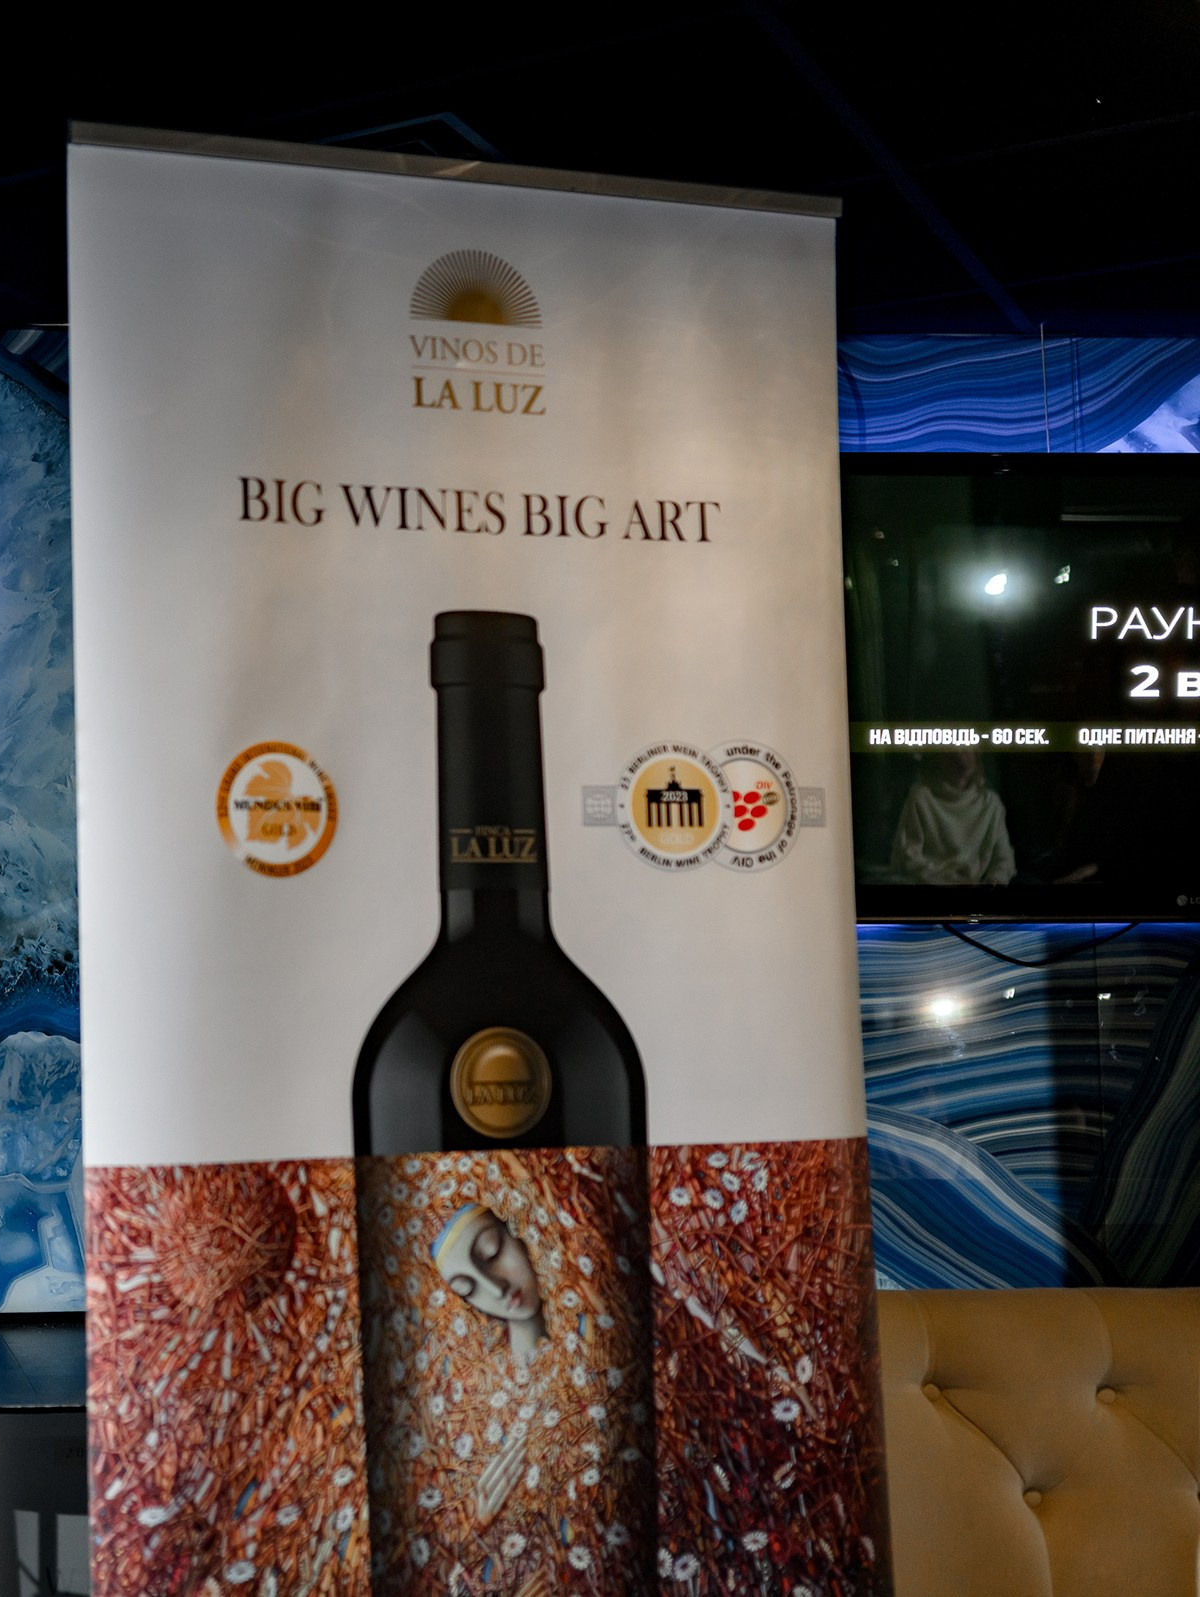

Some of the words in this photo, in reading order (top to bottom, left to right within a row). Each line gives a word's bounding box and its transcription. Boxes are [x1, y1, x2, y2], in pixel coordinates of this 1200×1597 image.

[409, 334, 498, 363] VINOS
[506, 341, 546, 368] DE
[412, 375, 460, 410] LA
[472, 379, 547, 415] LUZ
[238, 475, 326, 527] BIG
[338, 483, 507, 536] WINES
[521, 492, 608, 539] BIG
[622, 498, 722, 543] ART
[1130, 664, 1160, 698] 2
[870, 728, 891, 745] НА
[894, 728, 980, 747] ВІДПОВІДЬ
[992, 728, 1013, 745] 60
[1015, 728, 1050, 745] СЕК.
[1079, 728, 1123, 746] ОДНЕ
[1125, 728, 1196, 745] ПИТАННЯ
[726, 744, 762, 757] under
[764, 752, 783, 770] the
[450, 835, 483, 858] LA
[487, 836, 539, 859] LUZ
